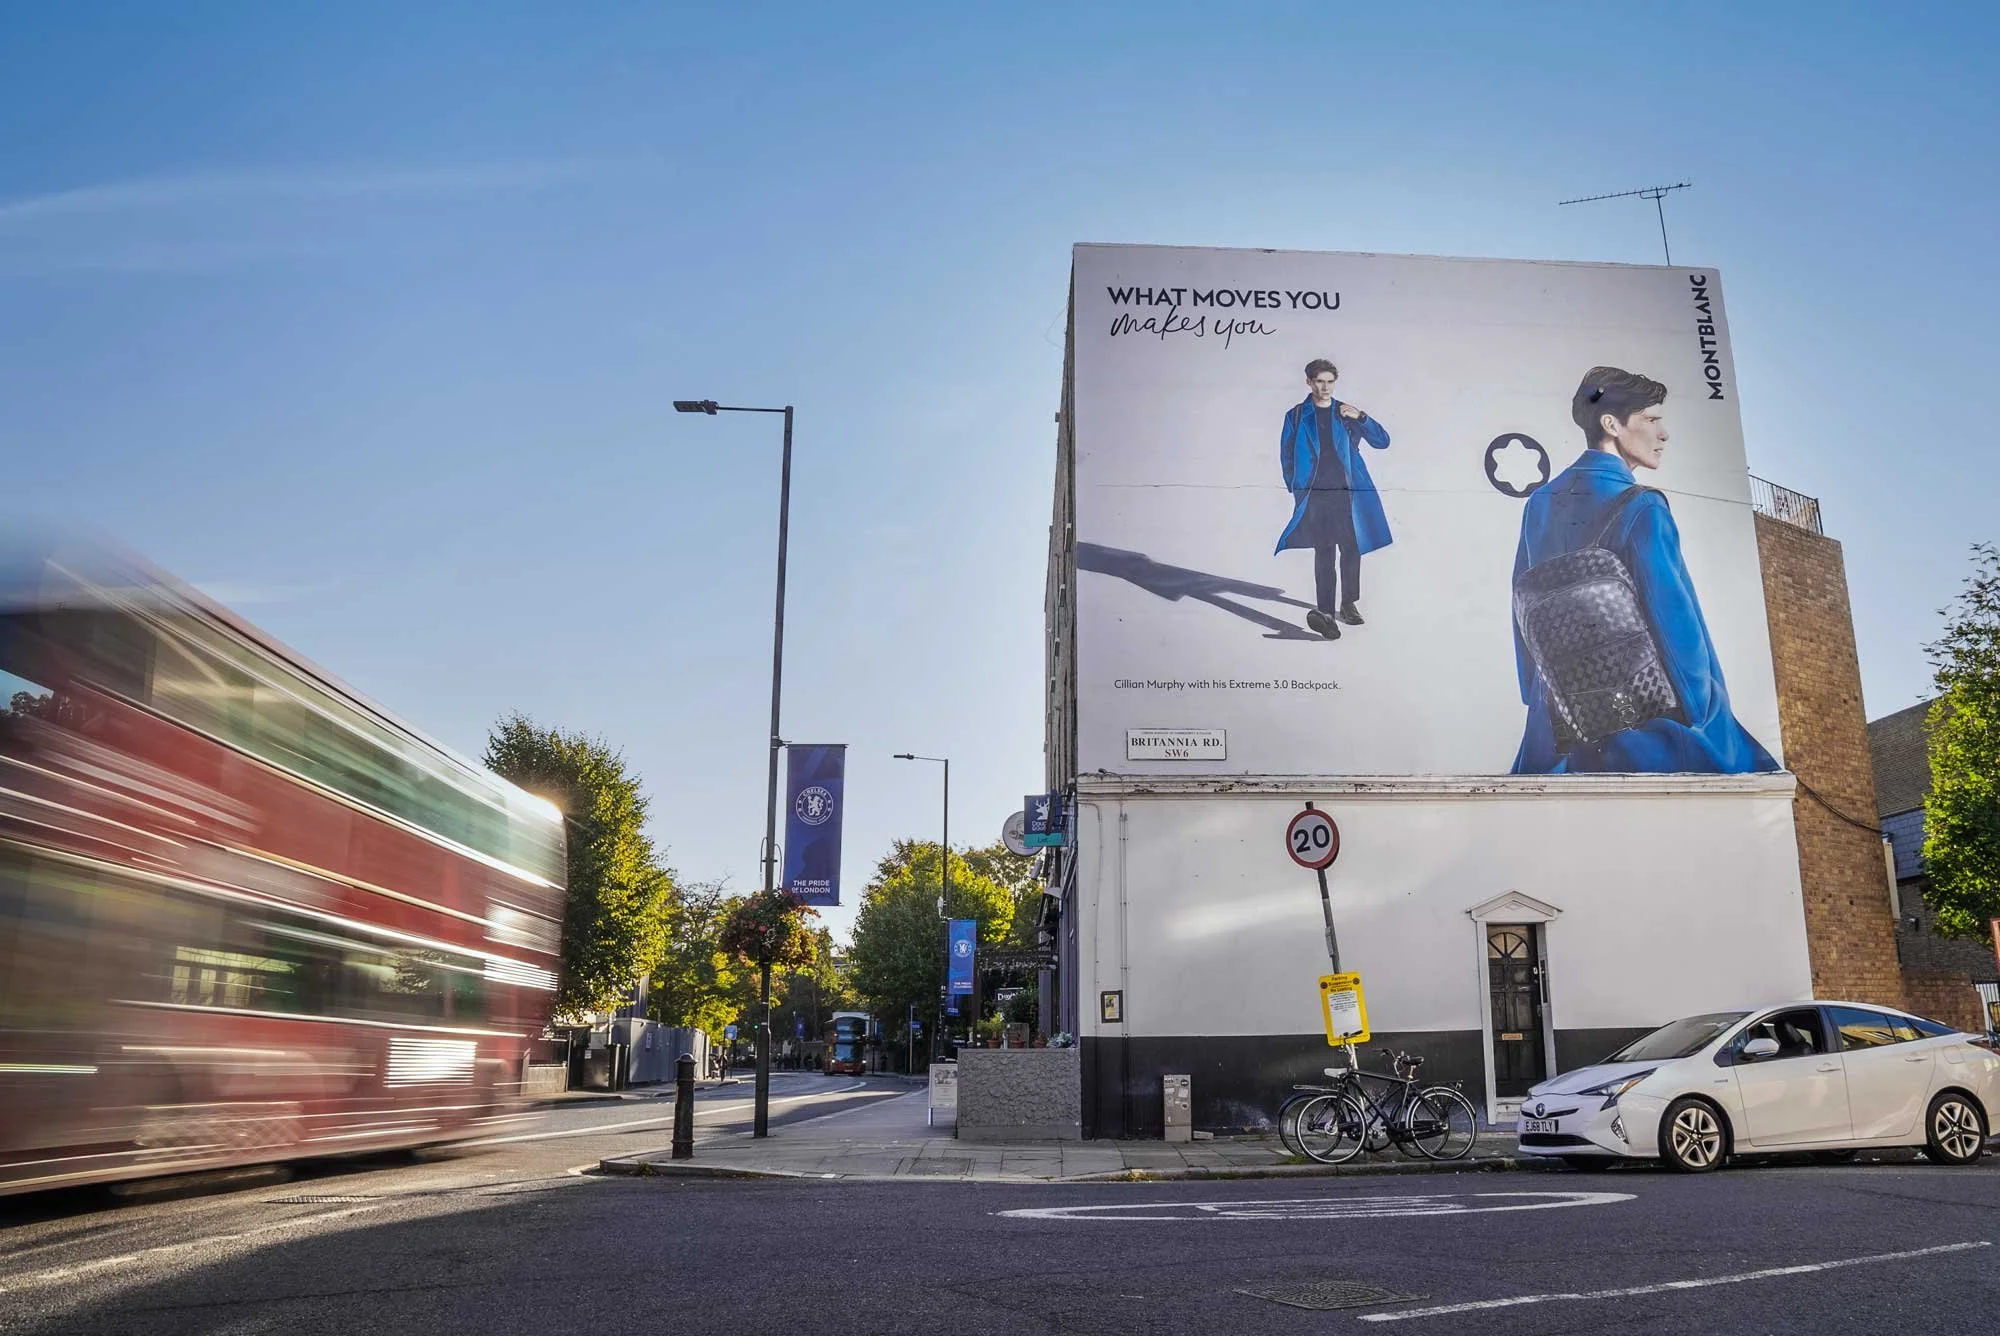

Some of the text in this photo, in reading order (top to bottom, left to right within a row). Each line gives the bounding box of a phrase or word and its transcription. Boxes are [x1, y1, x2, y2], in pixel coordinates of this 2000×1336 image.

[1106, 286, 1341, 311] WHAT MOVES YOU
[1110, 304, 1277, 350] makes you
[1689, 274, 1725, 401] MONTBLANC
[1113, 679, 1342, 692] Cillian Murphy with his Extreme 3.0 Backpack.
[1131, 737, 1223, 747] BRITANNIA RD.
[1164, 749, 1189, 758] SW6
[1293, 824, 1330, 854] 20
[793, 879, 830, 887] THE PRIDE
